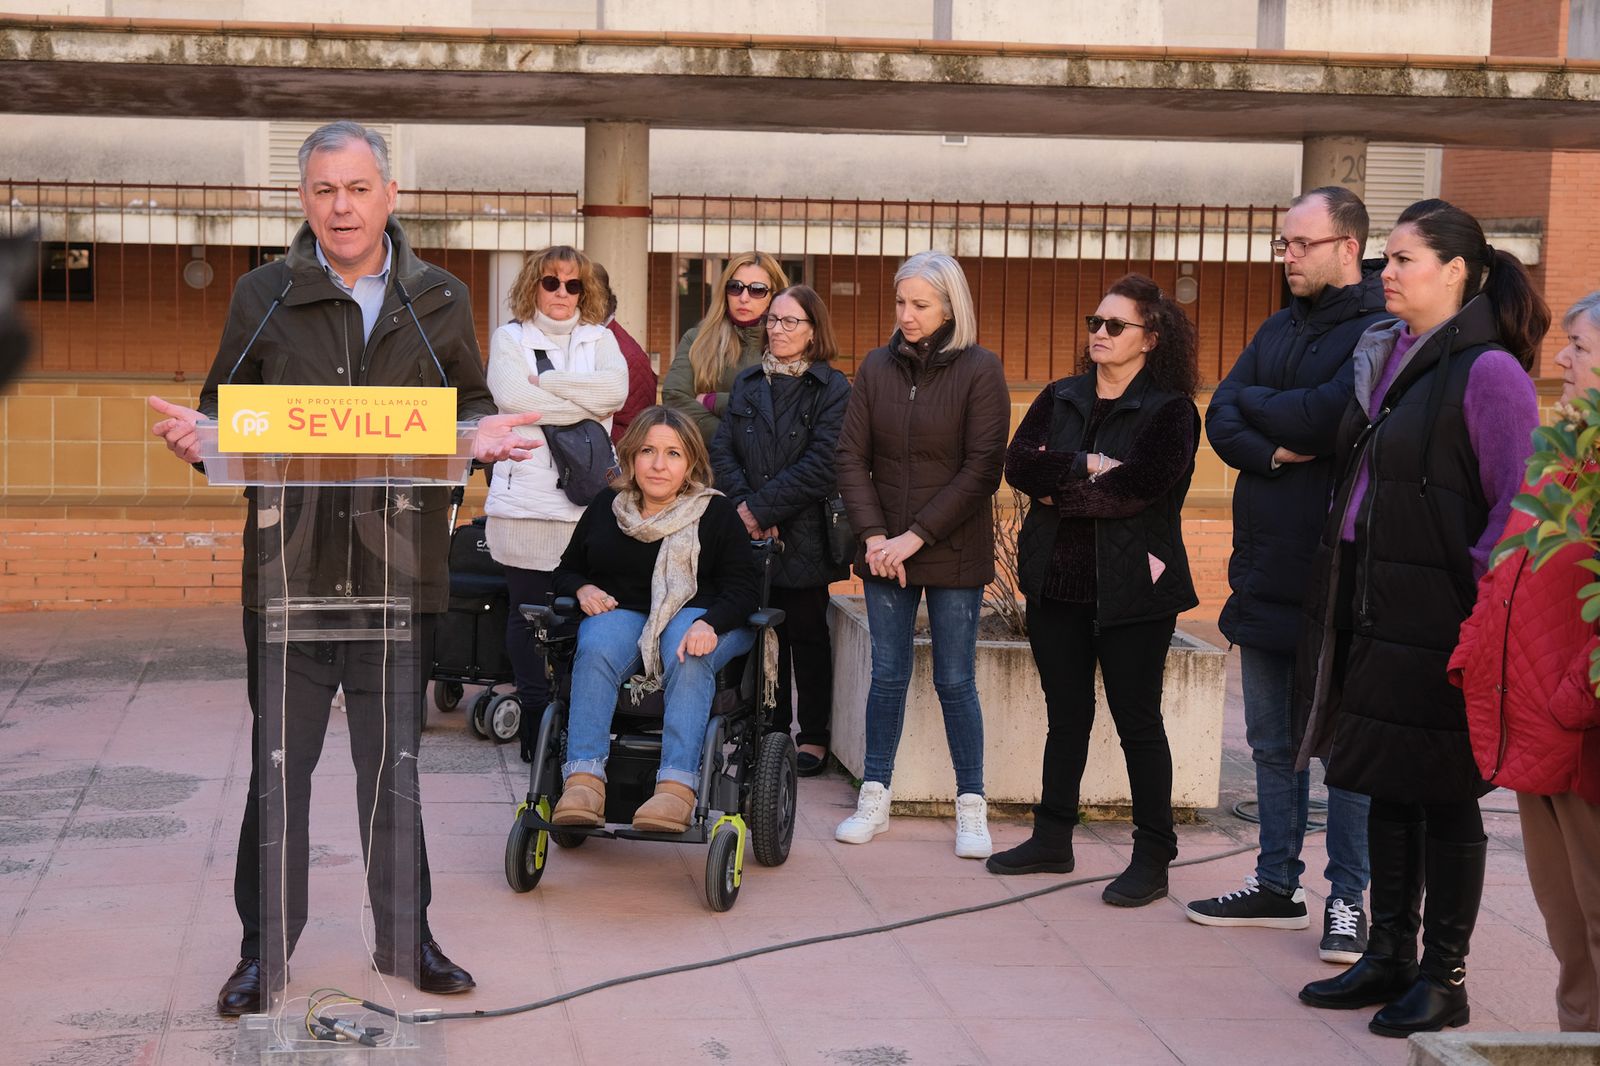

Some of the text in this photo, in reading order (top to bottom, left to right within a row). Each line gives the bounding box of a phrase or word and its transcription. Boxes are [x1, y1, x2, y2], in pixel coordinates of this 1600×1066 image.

[308, 398, 368, 406] PROYECTO
[374, 399, 428, 407] LLAMADO
[288, 407, 427, 438] SEVILLA
